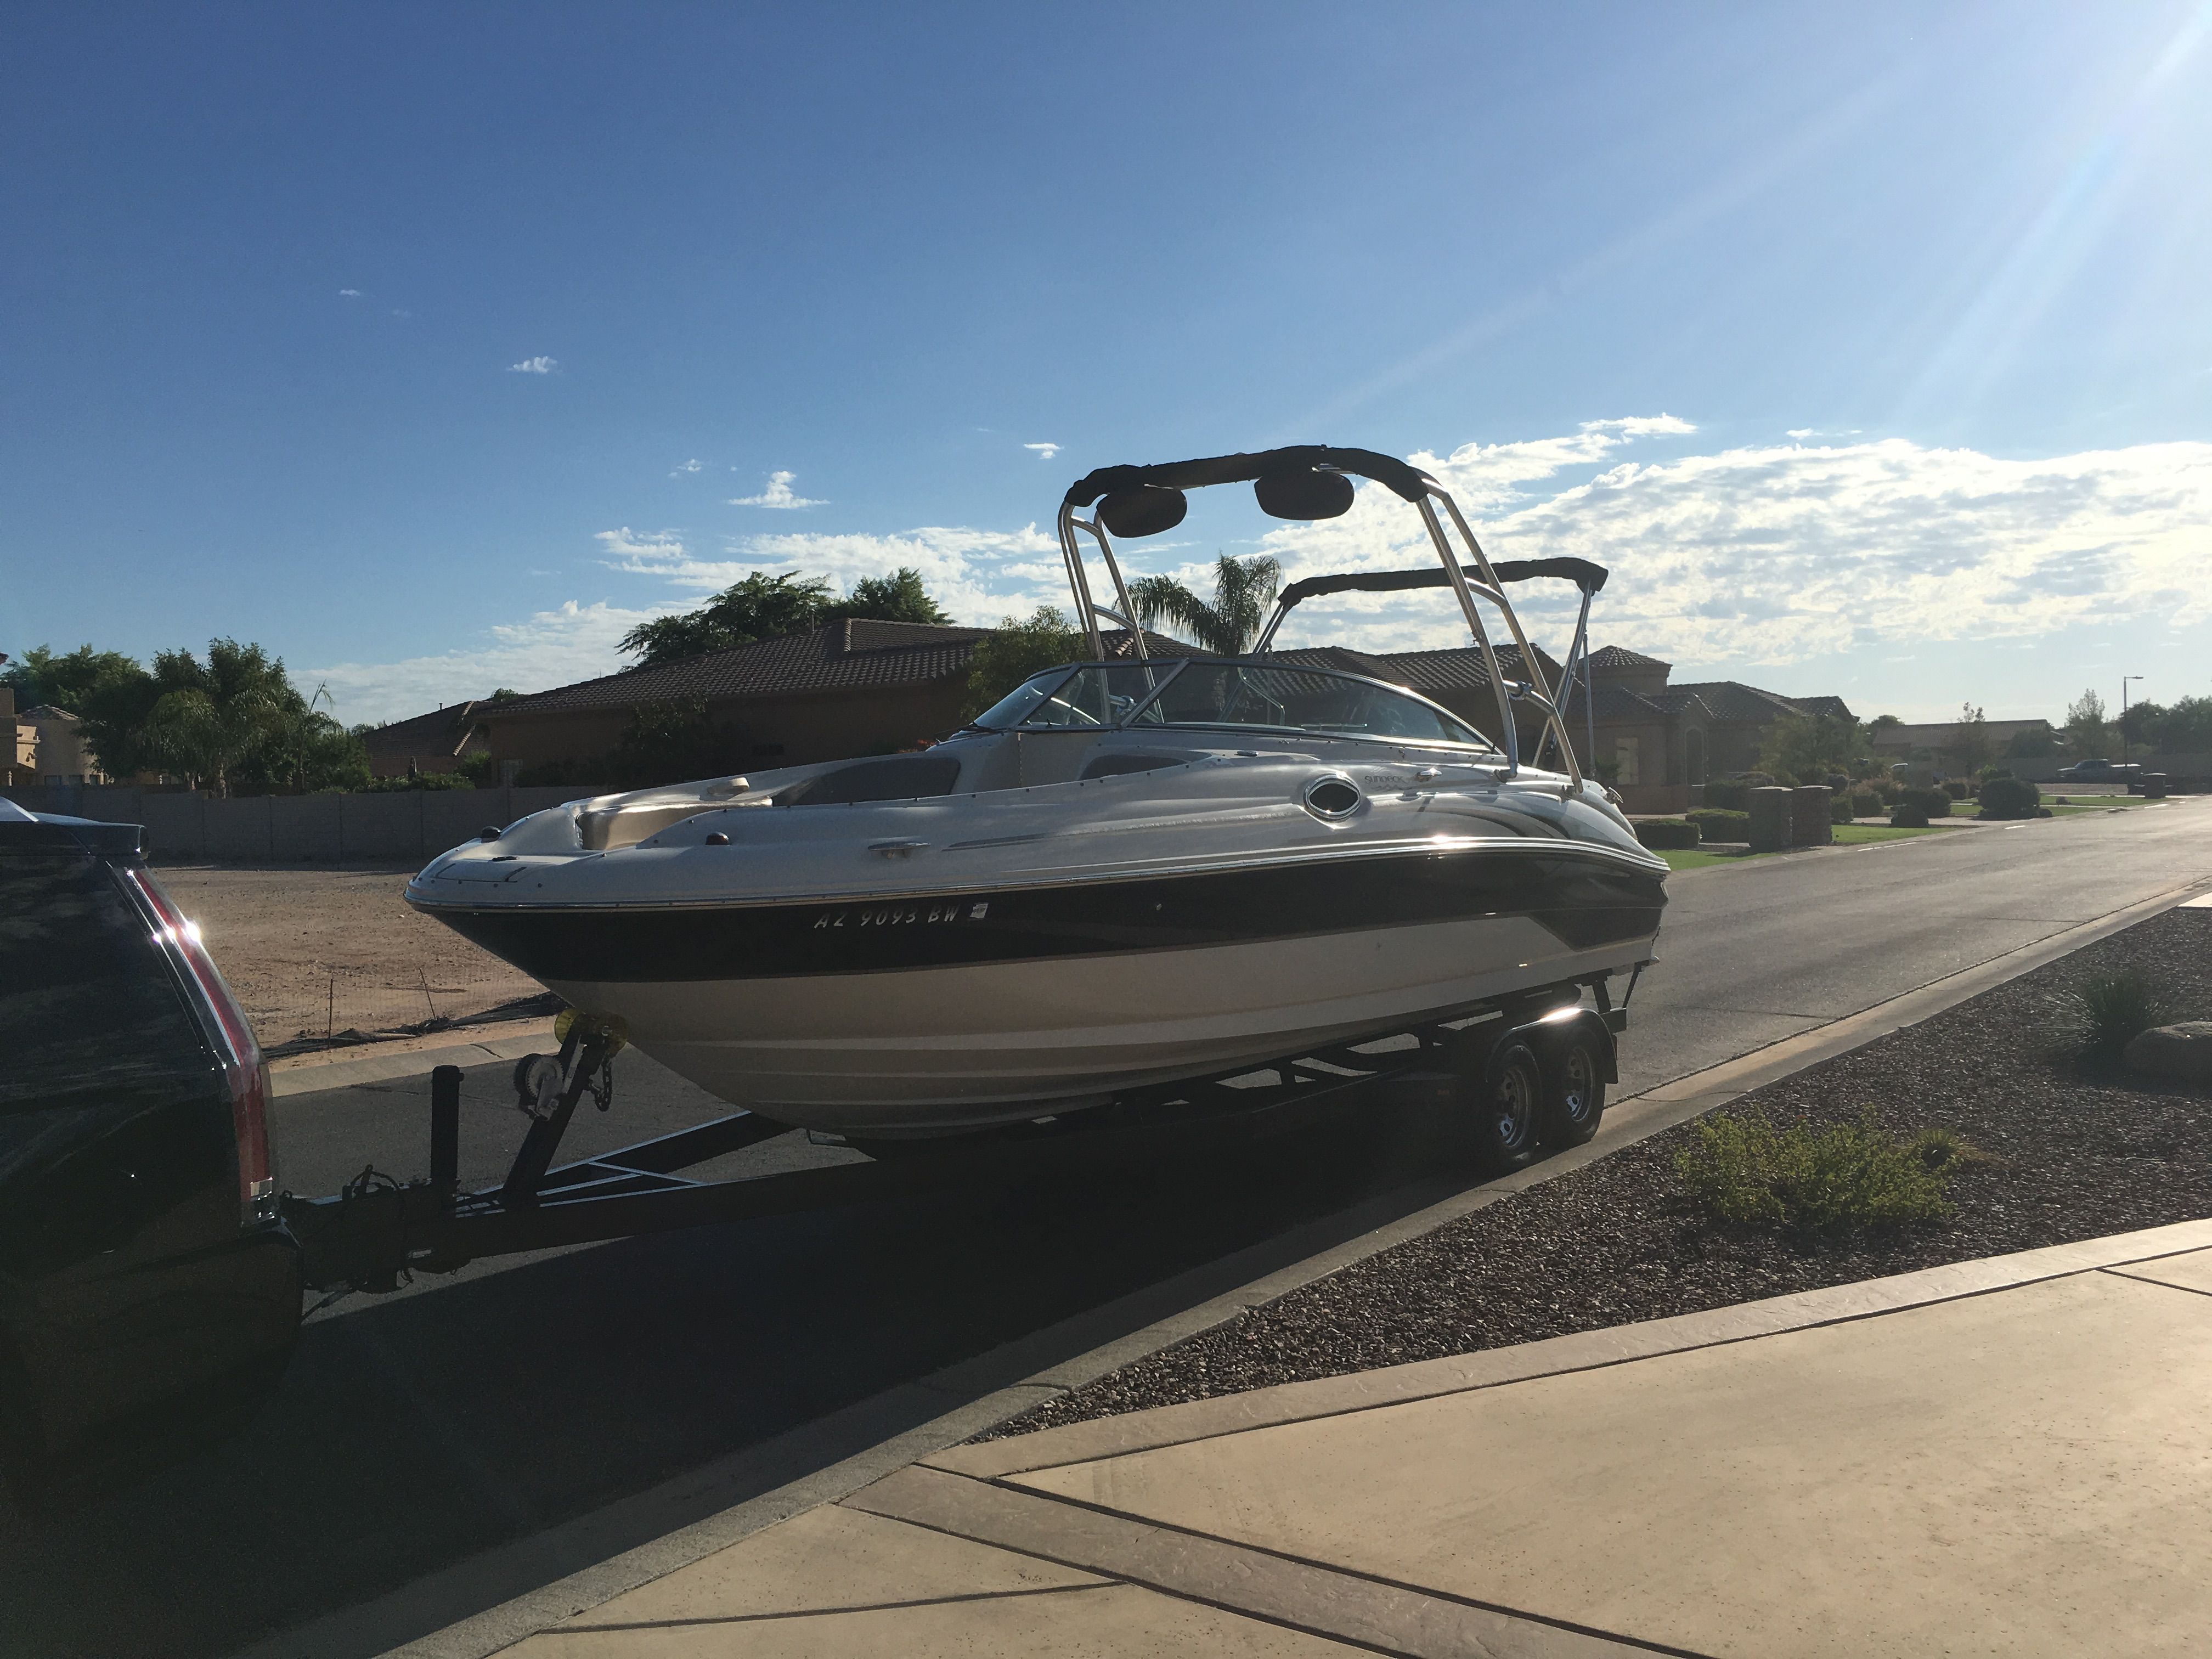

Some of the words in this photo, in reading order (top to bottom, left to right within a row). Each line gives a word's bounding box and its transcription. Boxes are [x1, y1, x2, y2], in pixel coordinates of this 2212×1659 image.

[814, 912, 848, 929] AZ
[860, 907, 918, 927] 9093
[928, 904, 960, 923] BW
